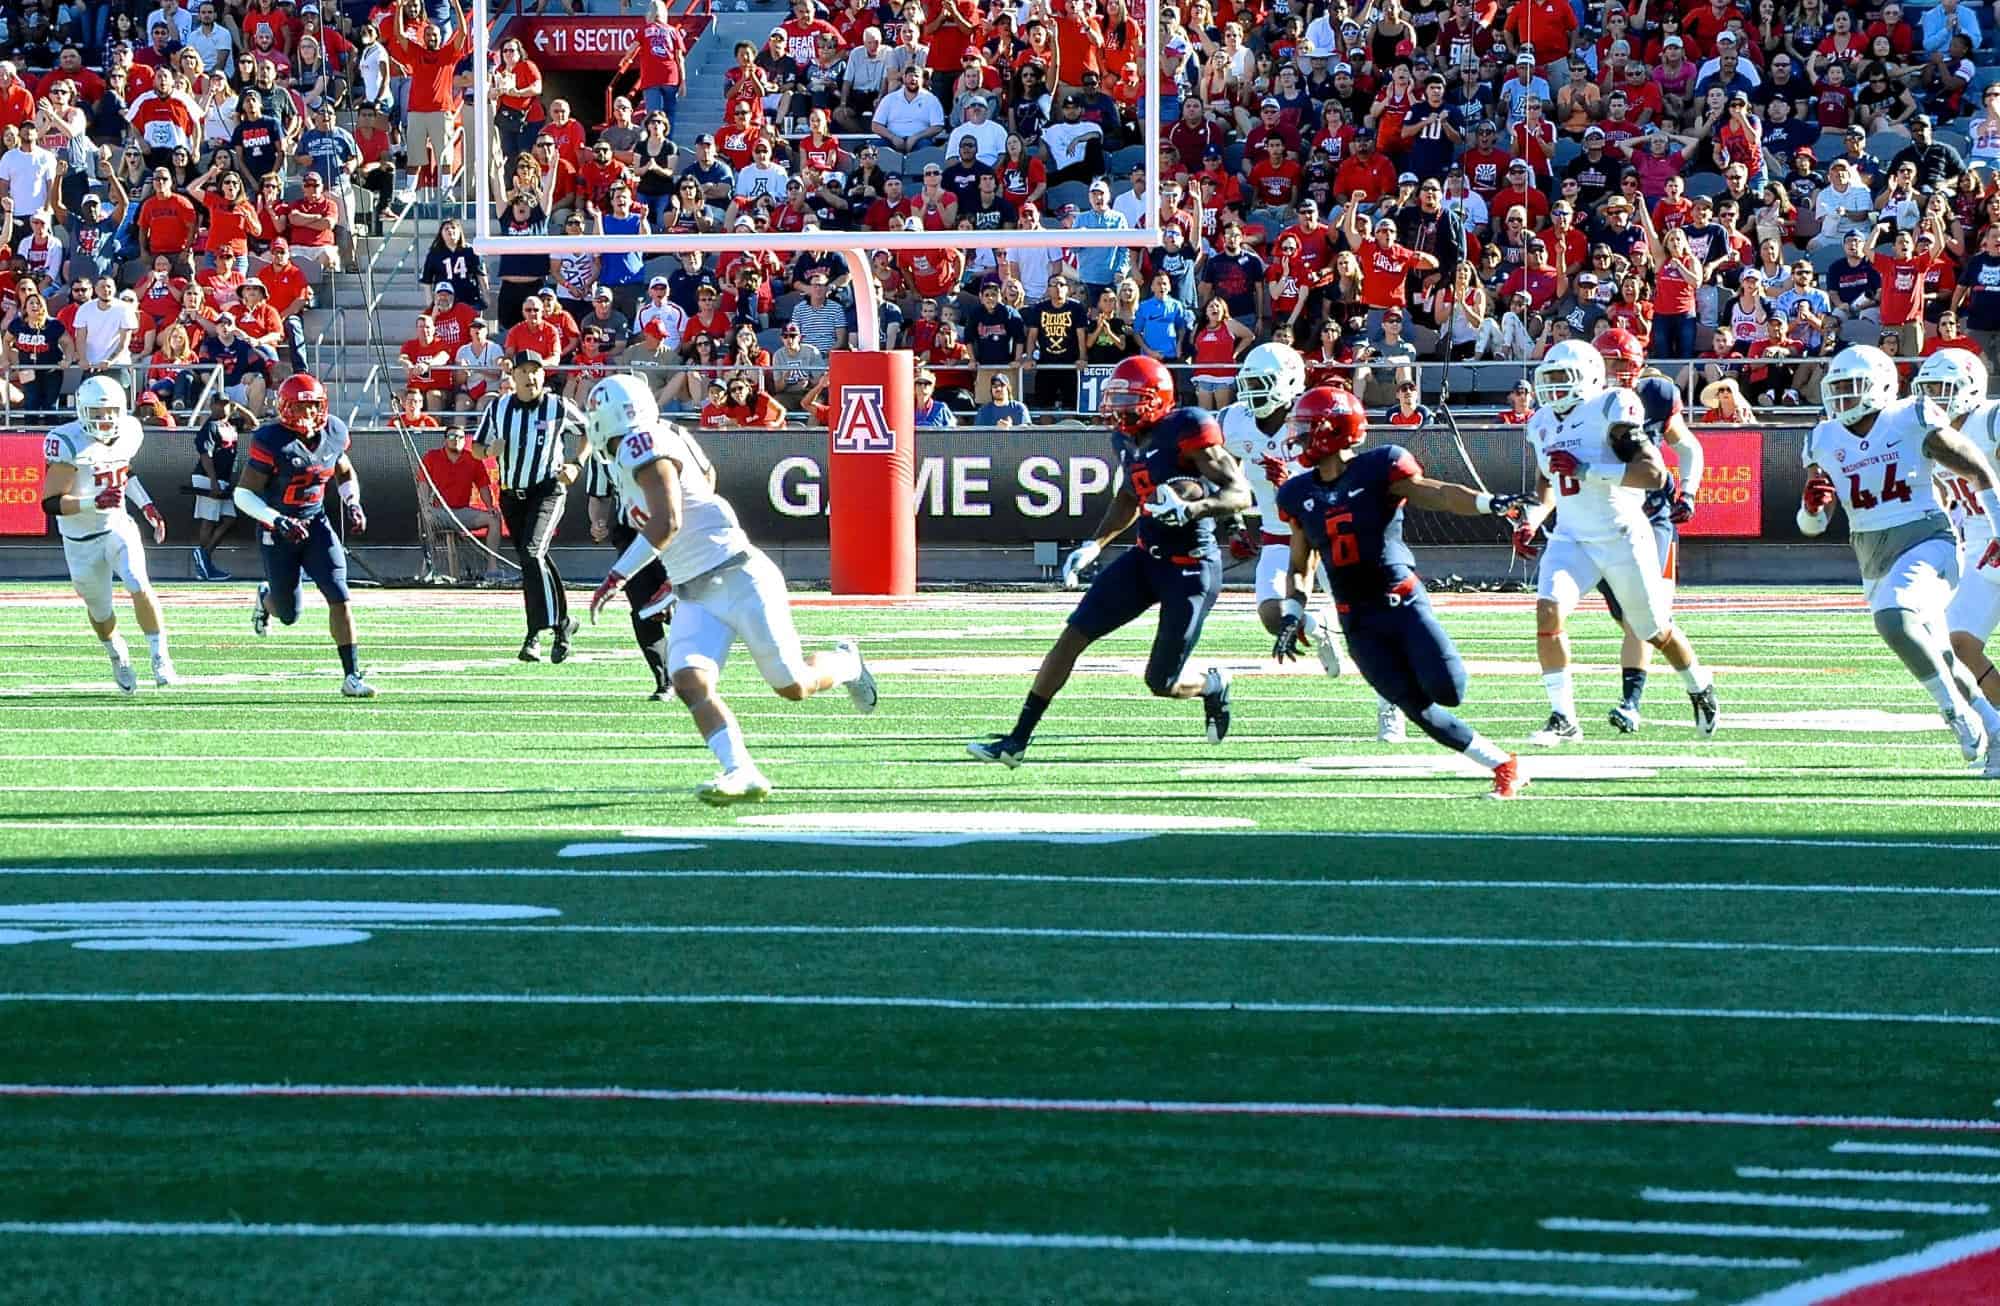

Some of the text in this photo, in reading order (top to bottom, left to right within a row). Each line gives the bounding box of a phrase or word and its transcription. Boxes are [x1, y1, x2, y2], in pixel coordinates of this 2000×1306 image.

[552, 29, 567, 51] 11
[573, 28, 639, 51] SECTIO
[788, 35, 814, 47] BEAR
[243, 136, 271, 149] DOWN
[442, 256, 467, 279] 14
[1041, 311, 1073, 325] EXCUSES
[18, 333, 47, 345] BEAR
[1045, 324, 1068, 337] SUCK
[833, 385, 896, 454] A
[44, 438, 60, 457] 29
[625, 431, 654, 459] 30
[1841, 451, 1900, 474] WASHINGTON STATE
[1015, 455, 1123, 517] SP
[1848, 462, 1913, 510] 44
[1325, 512, 1360, 568] 6
